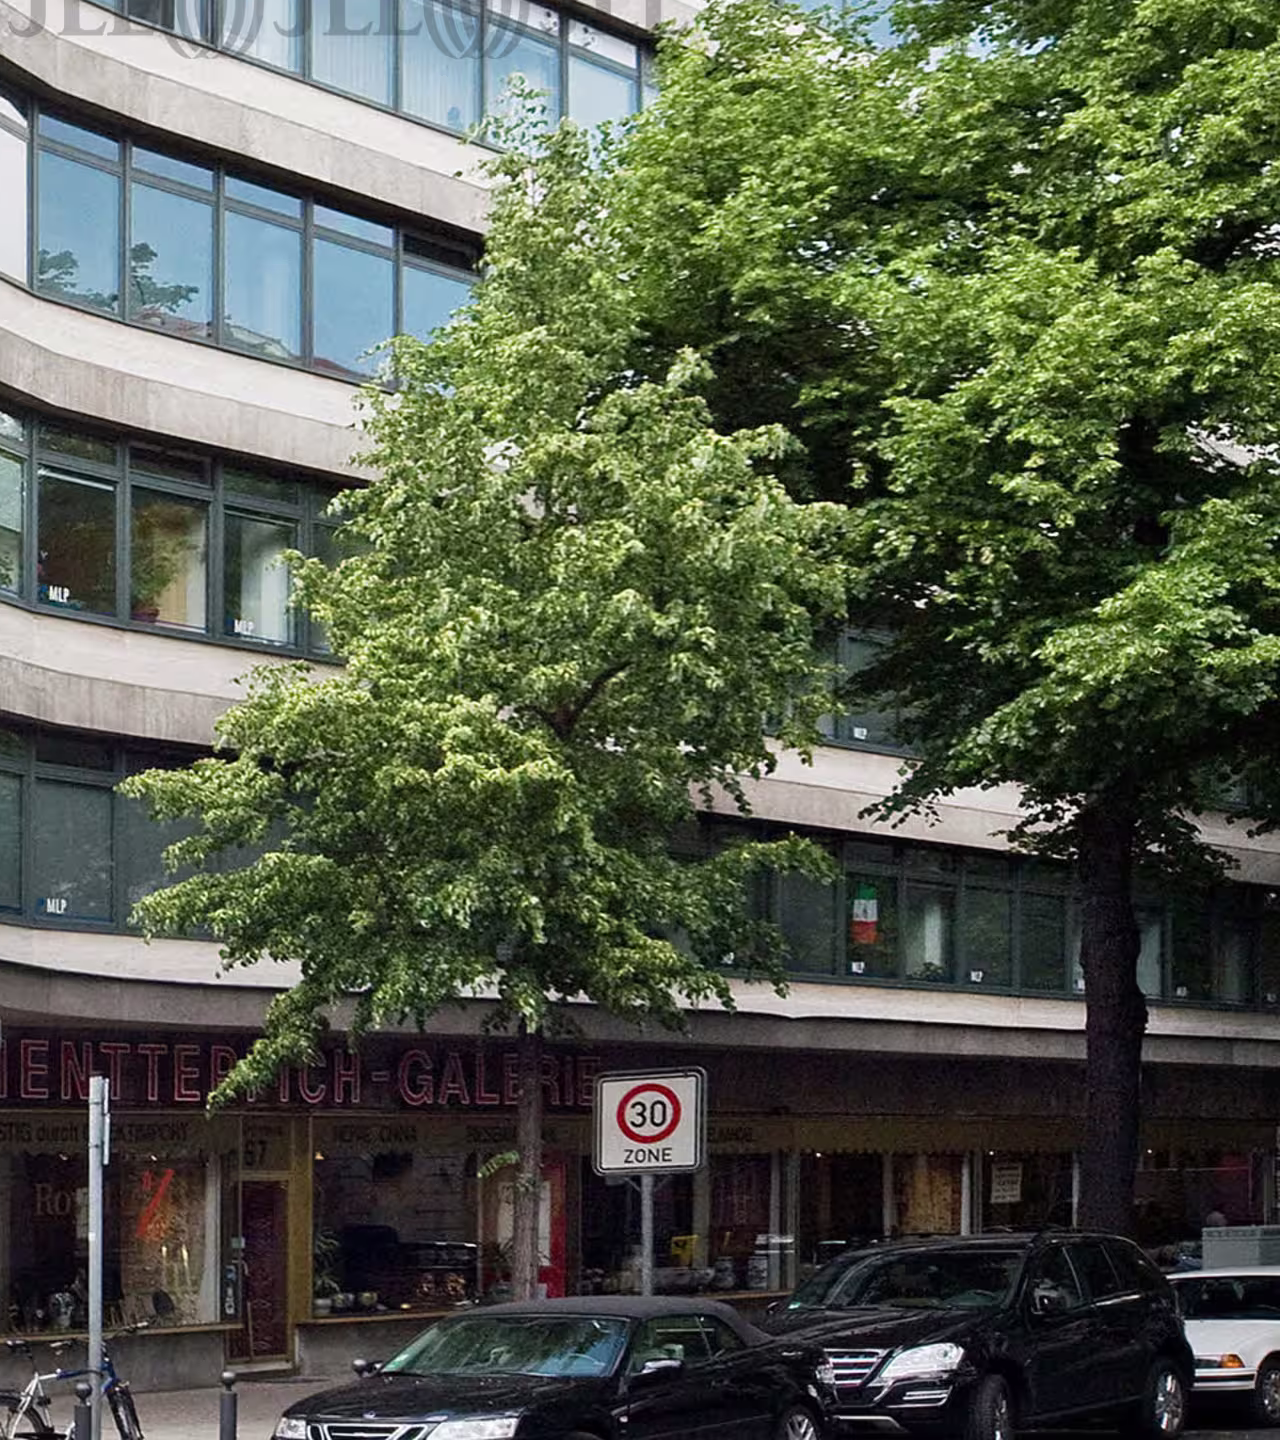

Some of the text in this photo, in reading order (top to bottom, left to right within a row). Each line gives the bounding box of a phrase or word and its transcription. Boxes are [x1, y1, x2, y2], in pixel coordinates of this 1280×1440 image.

[48, 585, 70, 603] MLP
[233, 619, 255, 634] MLP
[46, 898, 68, 914] MLP
[630, 1100, 667, 1128] 30
[623, 1147, 673, 1164] ZONE
